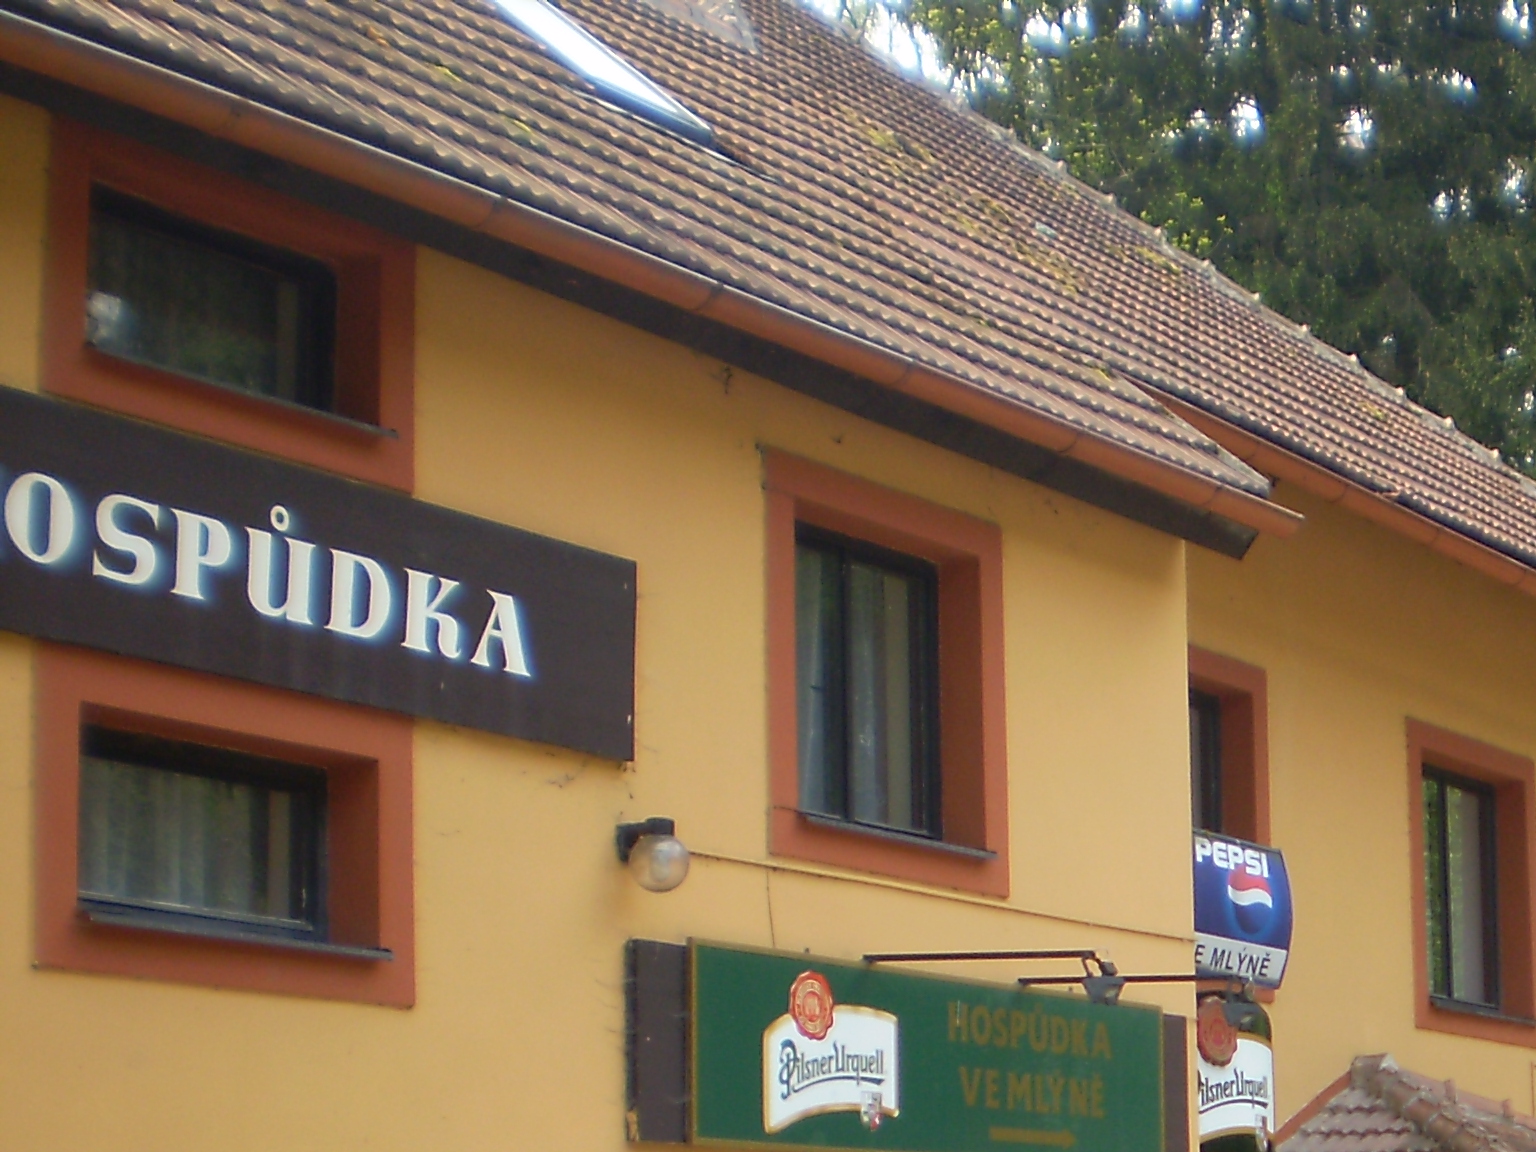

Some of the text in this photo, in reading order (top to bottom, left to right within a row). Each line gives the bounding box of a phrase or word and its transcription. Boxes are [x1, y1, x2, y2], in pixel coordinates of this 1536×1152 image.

[4, 472, 532, 677] OSPŮDKA
[1195, 836, 1269, 878] PEPSI
[1195, 944, 1272, 977] E MLÝNĚ
[778, 1039, 885, 1100] Pilsner Urquell
[958, 1066, 1000, 1109] VE
